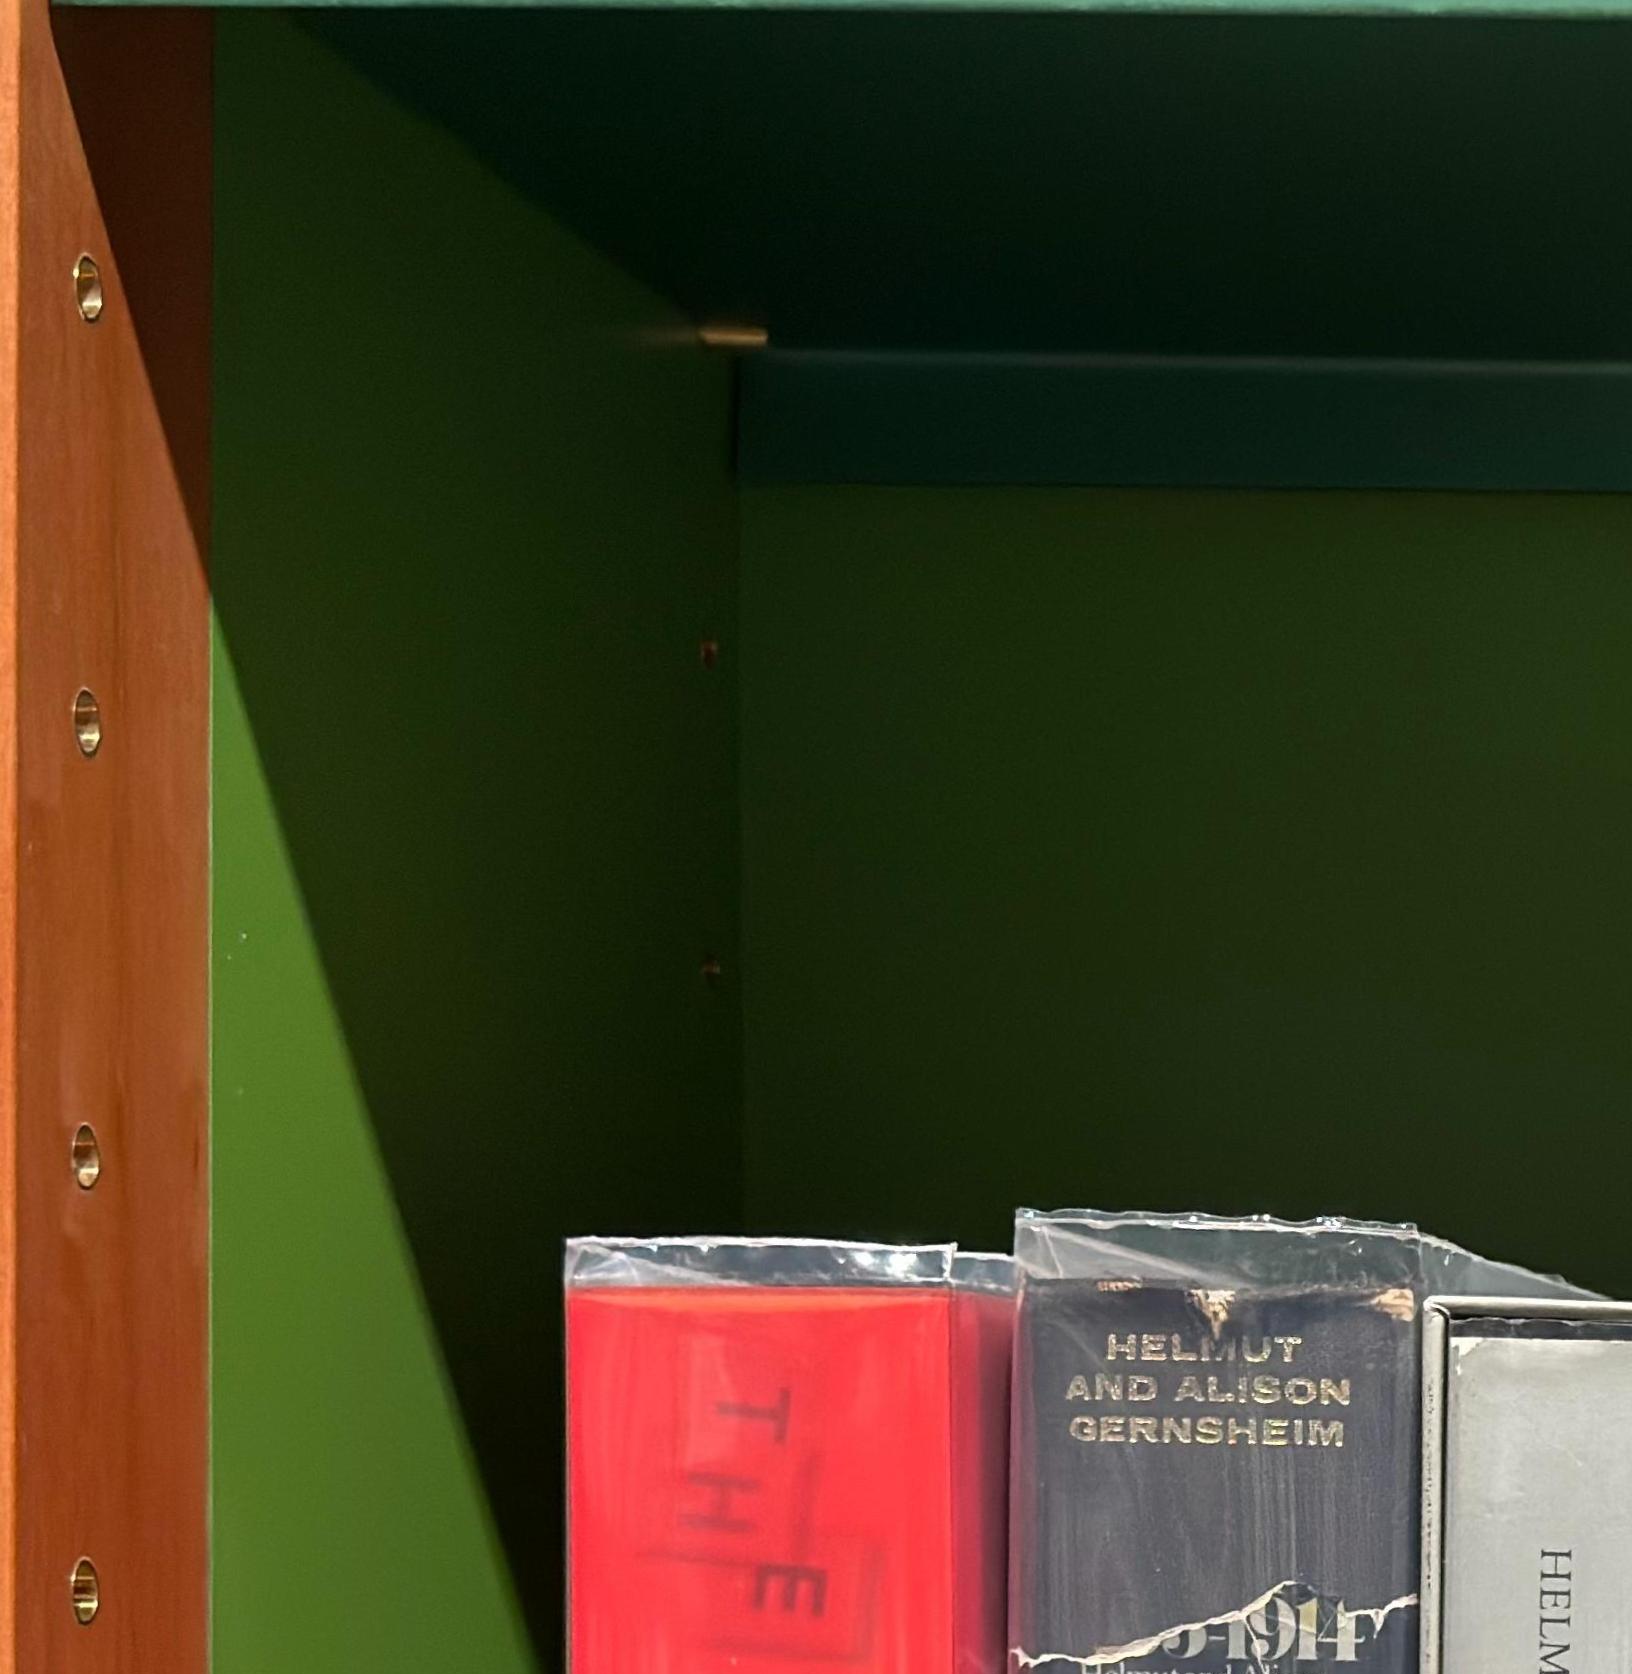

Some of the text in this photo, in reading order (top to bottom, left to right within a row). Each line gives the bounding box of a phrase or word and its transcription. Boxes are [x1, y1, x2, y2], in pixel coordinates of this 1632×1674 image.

[1105, 1332, 1303, 1364] HELMUT
[1065, 1374, 1352, 1406] AND ALISON
[1068, 1415, 1345, 1448] GERNSHEIM
[680, 1386, 831, 1619] THE
